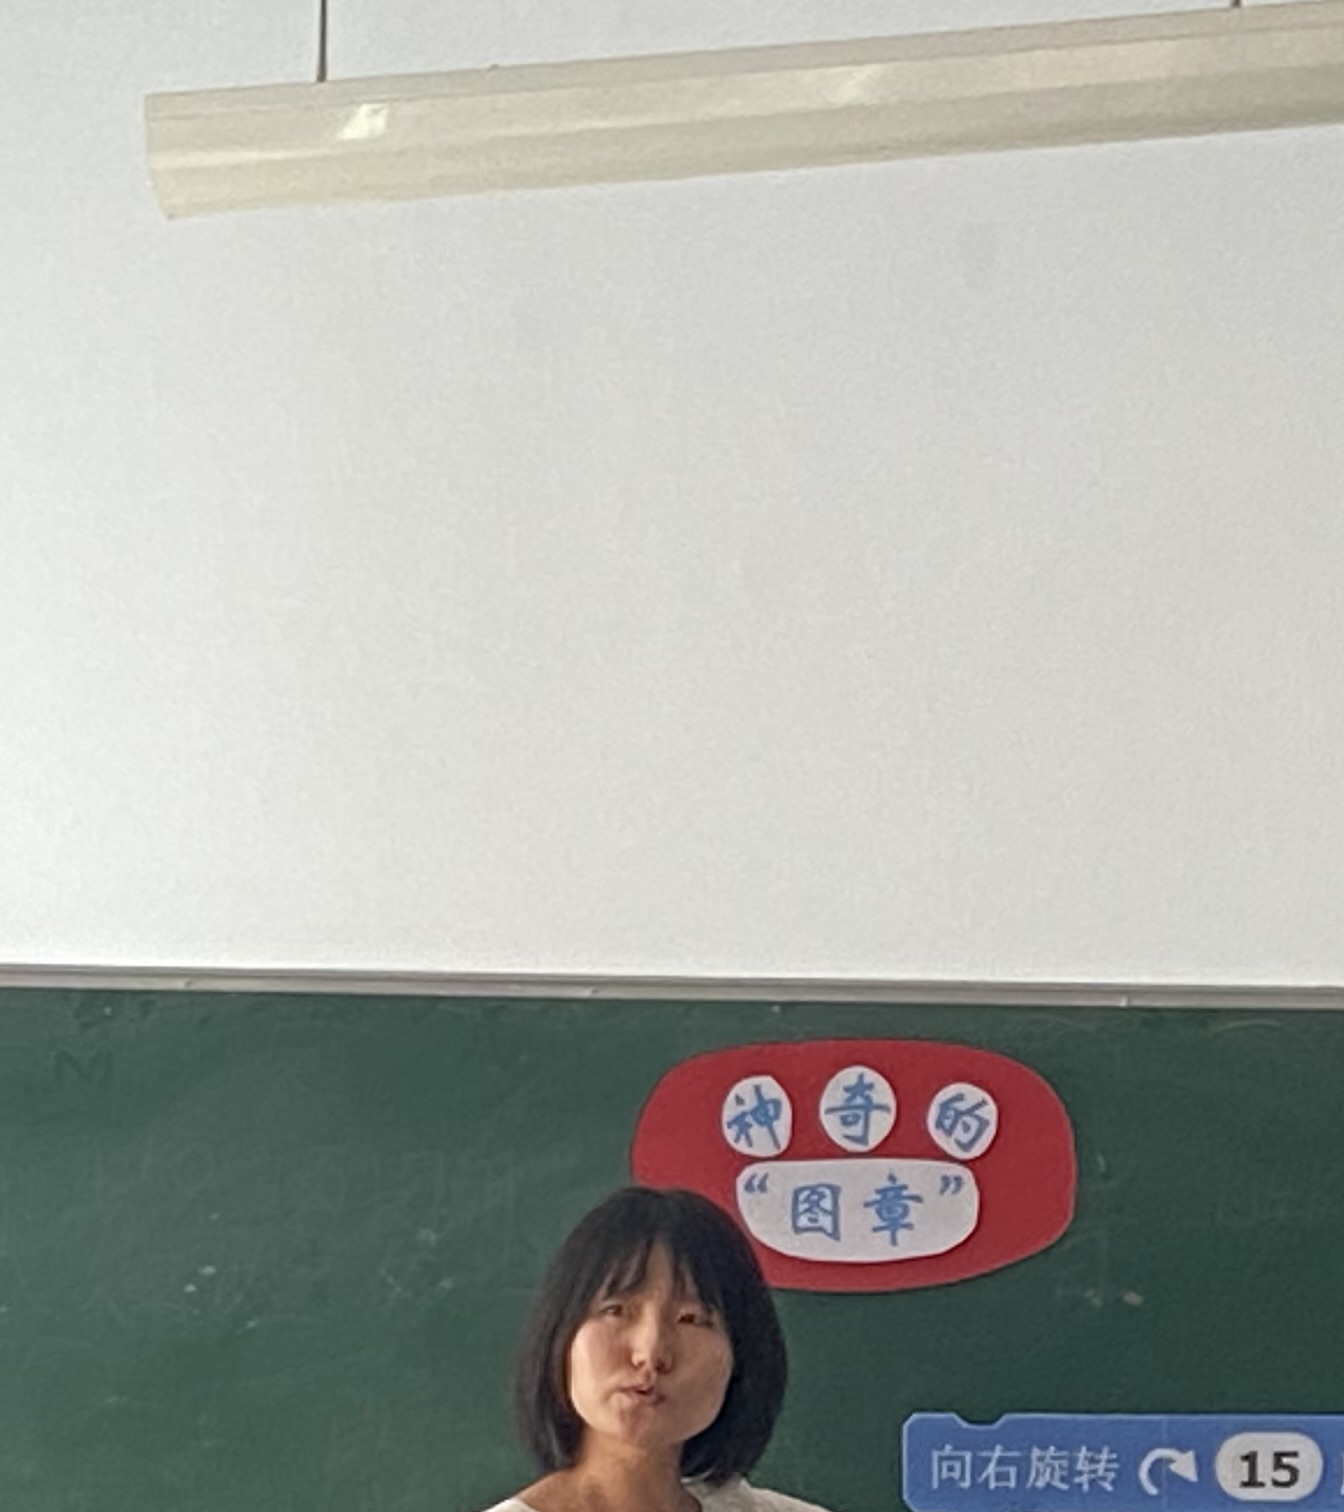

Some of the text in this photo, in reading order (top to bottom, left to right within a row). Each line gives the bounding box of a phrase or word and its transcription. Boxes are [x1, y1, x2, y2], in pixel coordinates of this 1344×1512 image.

[725, 1071, 990, 1153] 神奇的
[931, 1444, 1120, 1492] 向右旋转
[1238, 1450, 1301, 1489] 15
